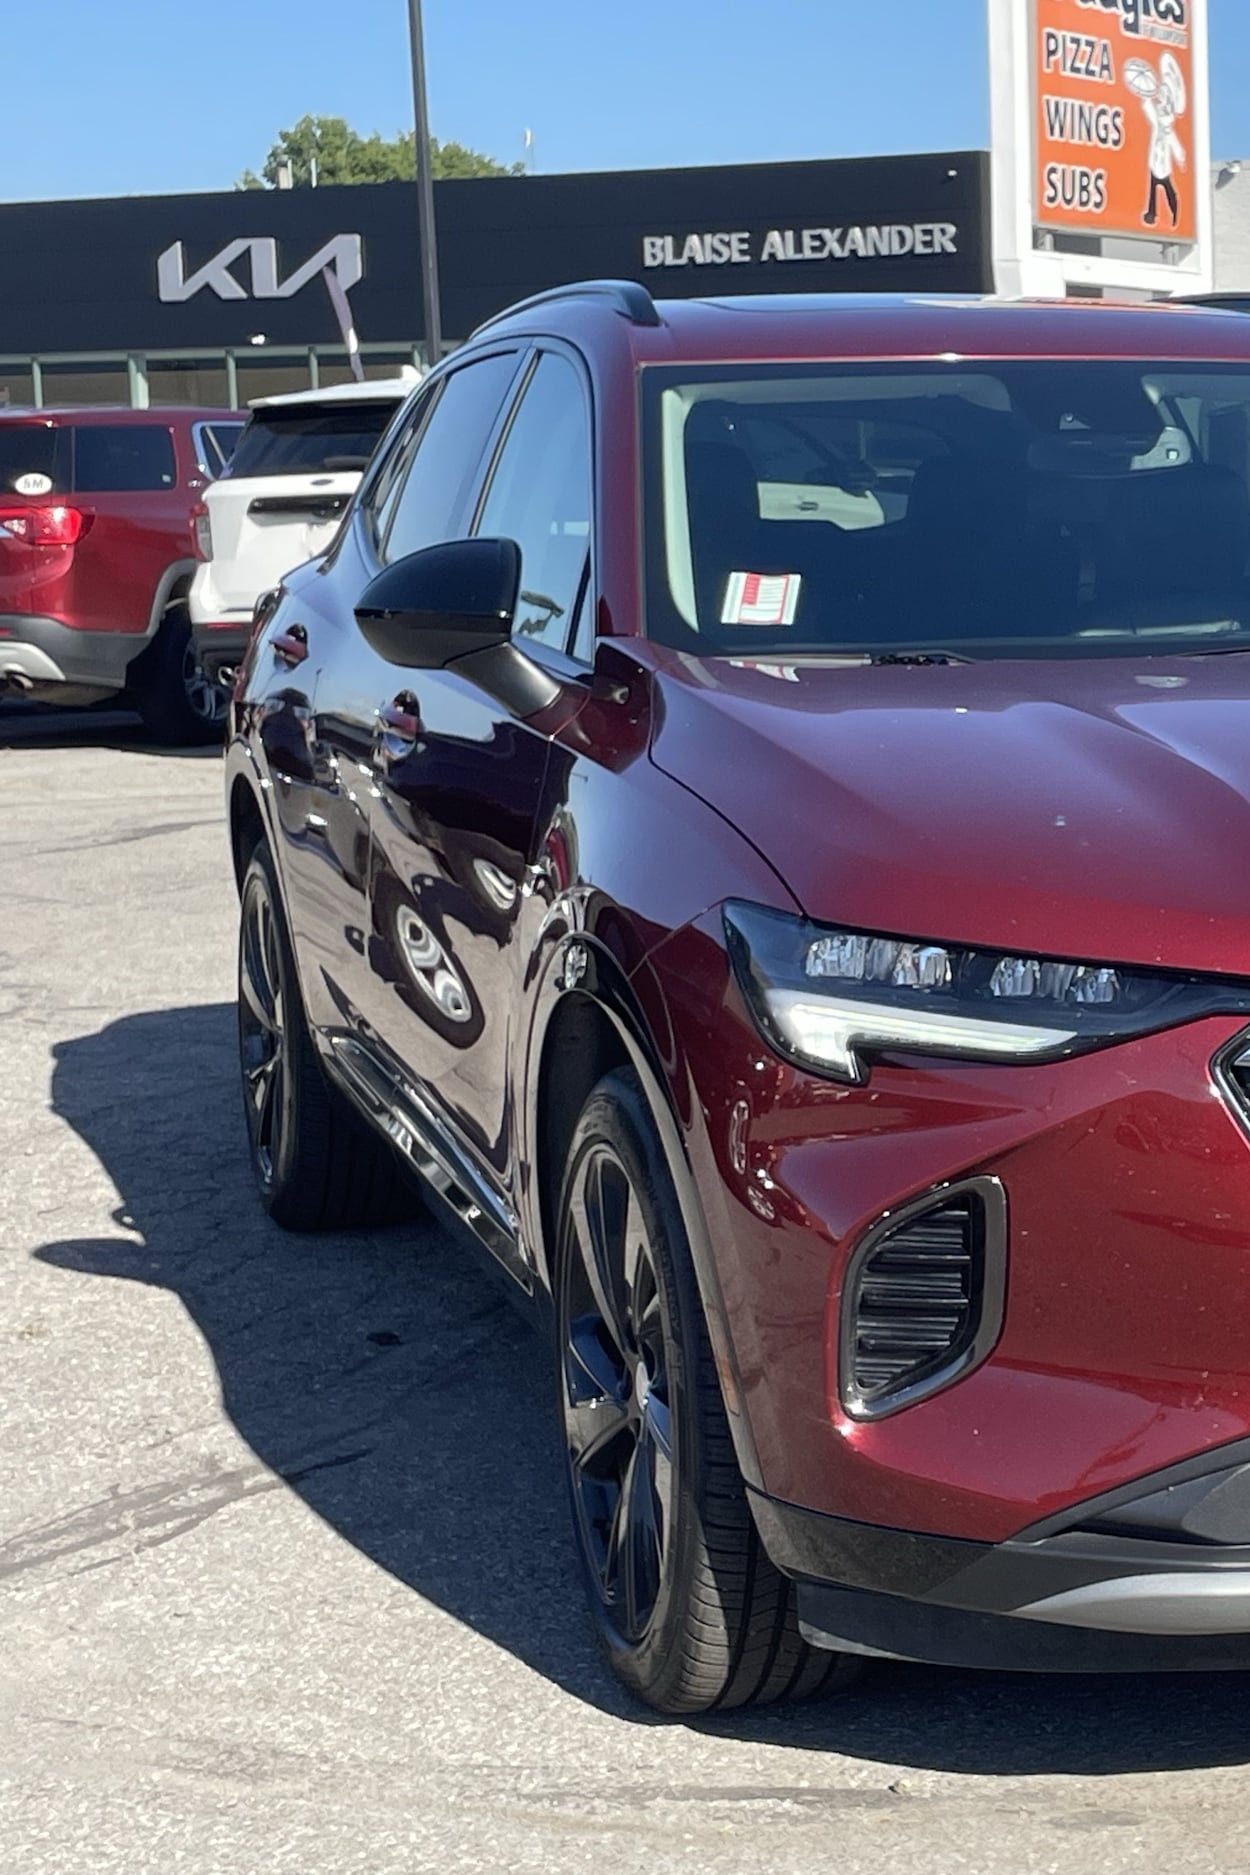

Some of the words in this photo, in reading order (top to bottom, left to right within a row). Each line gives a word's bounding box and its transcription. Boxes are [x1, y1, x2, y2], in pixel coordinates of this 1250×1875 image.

[1045, 31, 1112, 81] PIZZA
[1045, 98, 1121, 147] WINGS
[1046, 165, 1105, 209] SUBS
[157, 233, 363, 302] KIA
[643, 231, 750, 267] BLAISE
[760, 222, 957, 262] ALEXANDER
